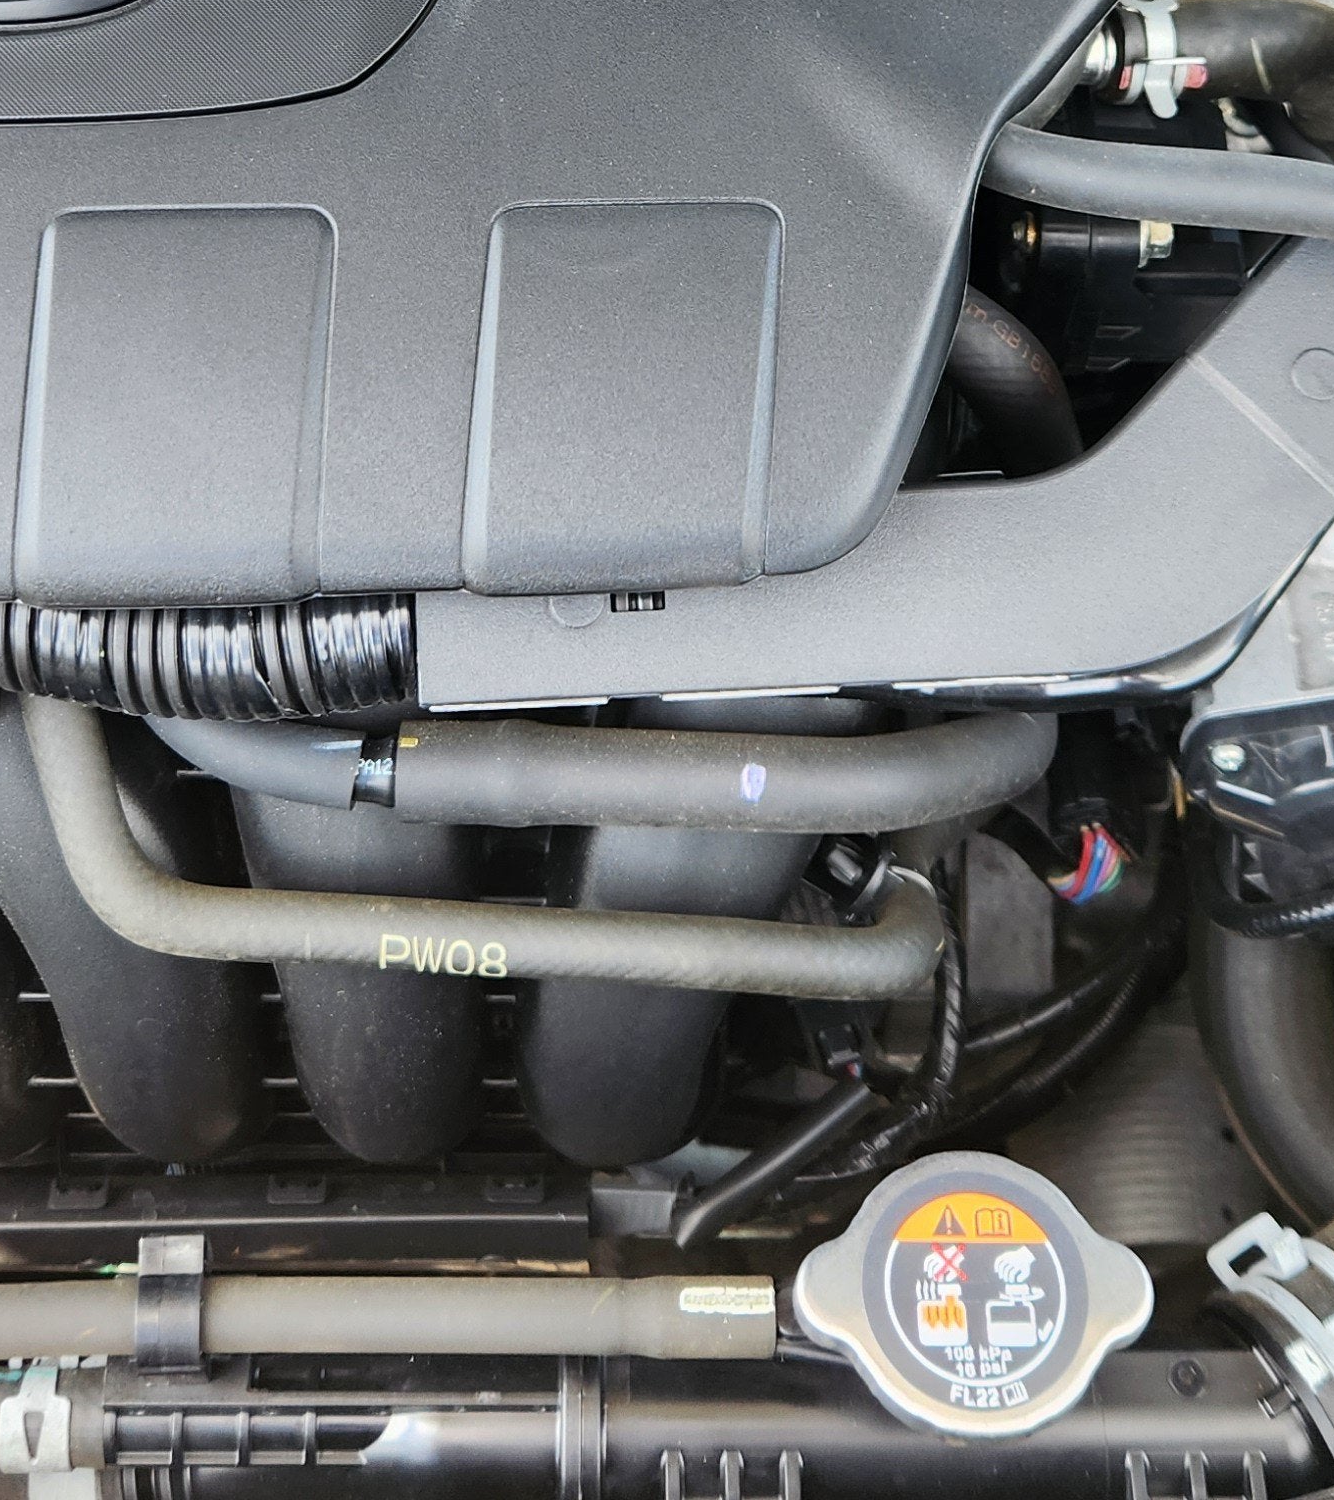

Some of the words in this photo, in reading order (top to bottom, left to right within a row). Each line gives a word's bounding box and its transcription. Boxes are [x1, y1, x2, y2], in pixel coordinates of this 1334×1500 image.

[378, 933, 508, 978] PW08
[979, 1344, 1013, 1362] kPa
[950, 1383, 1001, 1408] FL22
